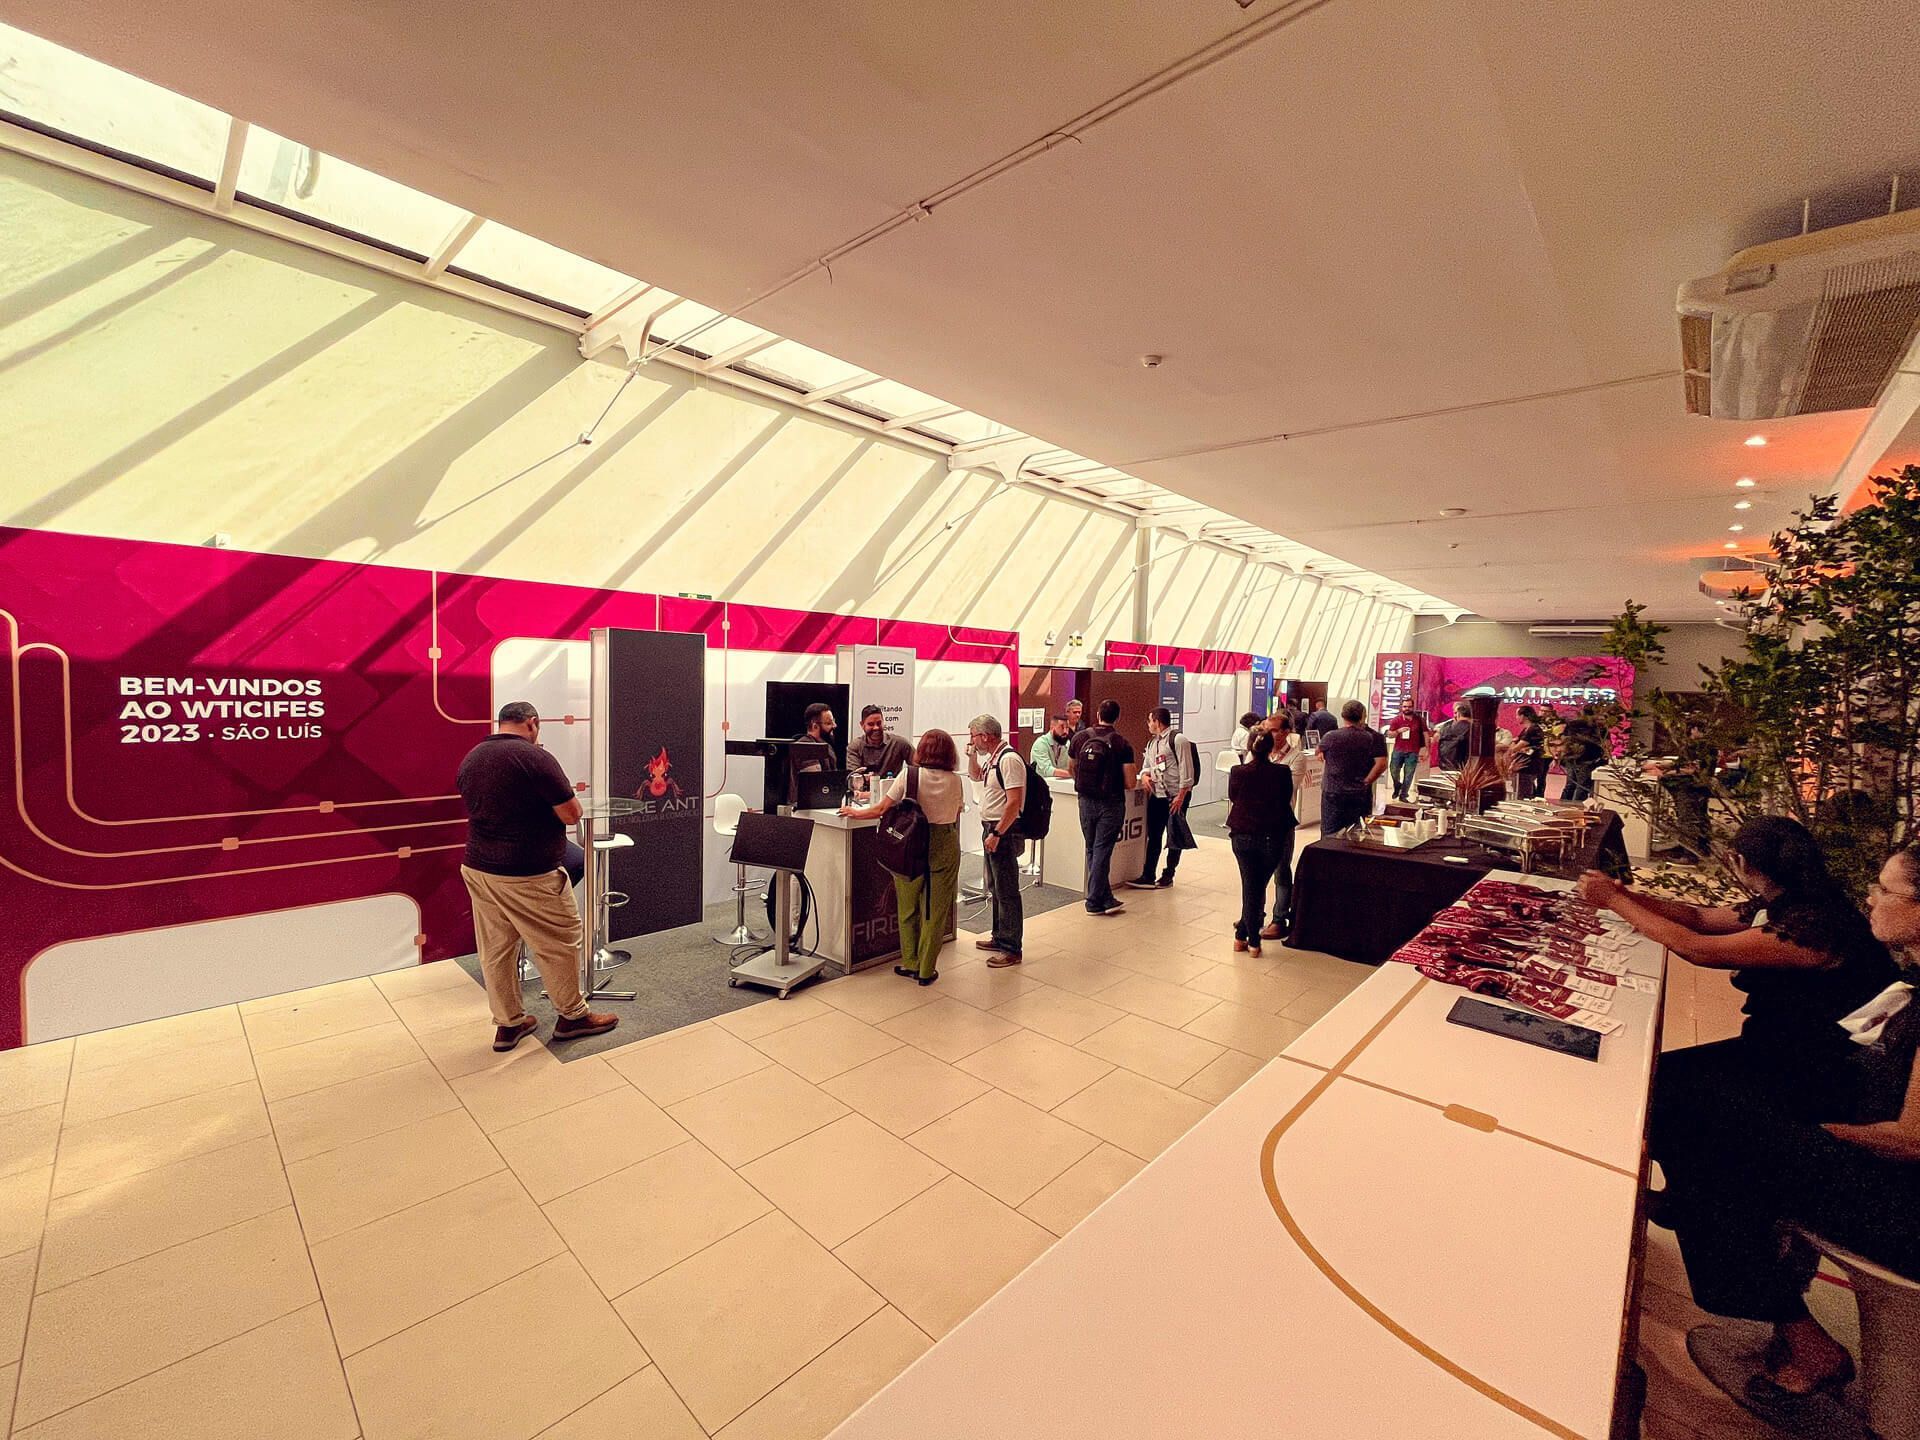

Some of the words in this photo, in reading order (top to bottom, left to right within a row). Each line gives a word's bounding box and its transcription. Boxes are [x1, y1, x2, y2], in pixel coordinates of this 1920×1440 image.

[120, 677, 322, 696] BEM-VINDOS
[1382, 660, 1403, 720] WTICIFES
[119, 701, 172, 720] AO
[180, 701, 326, 719] WTICIFES
[120, 724, 201, 744] 2023
[221, 723, 270, 740] SÃO
[277, 722, 323, 740] LUÍS
[661, 796, 700, 812] ANT
